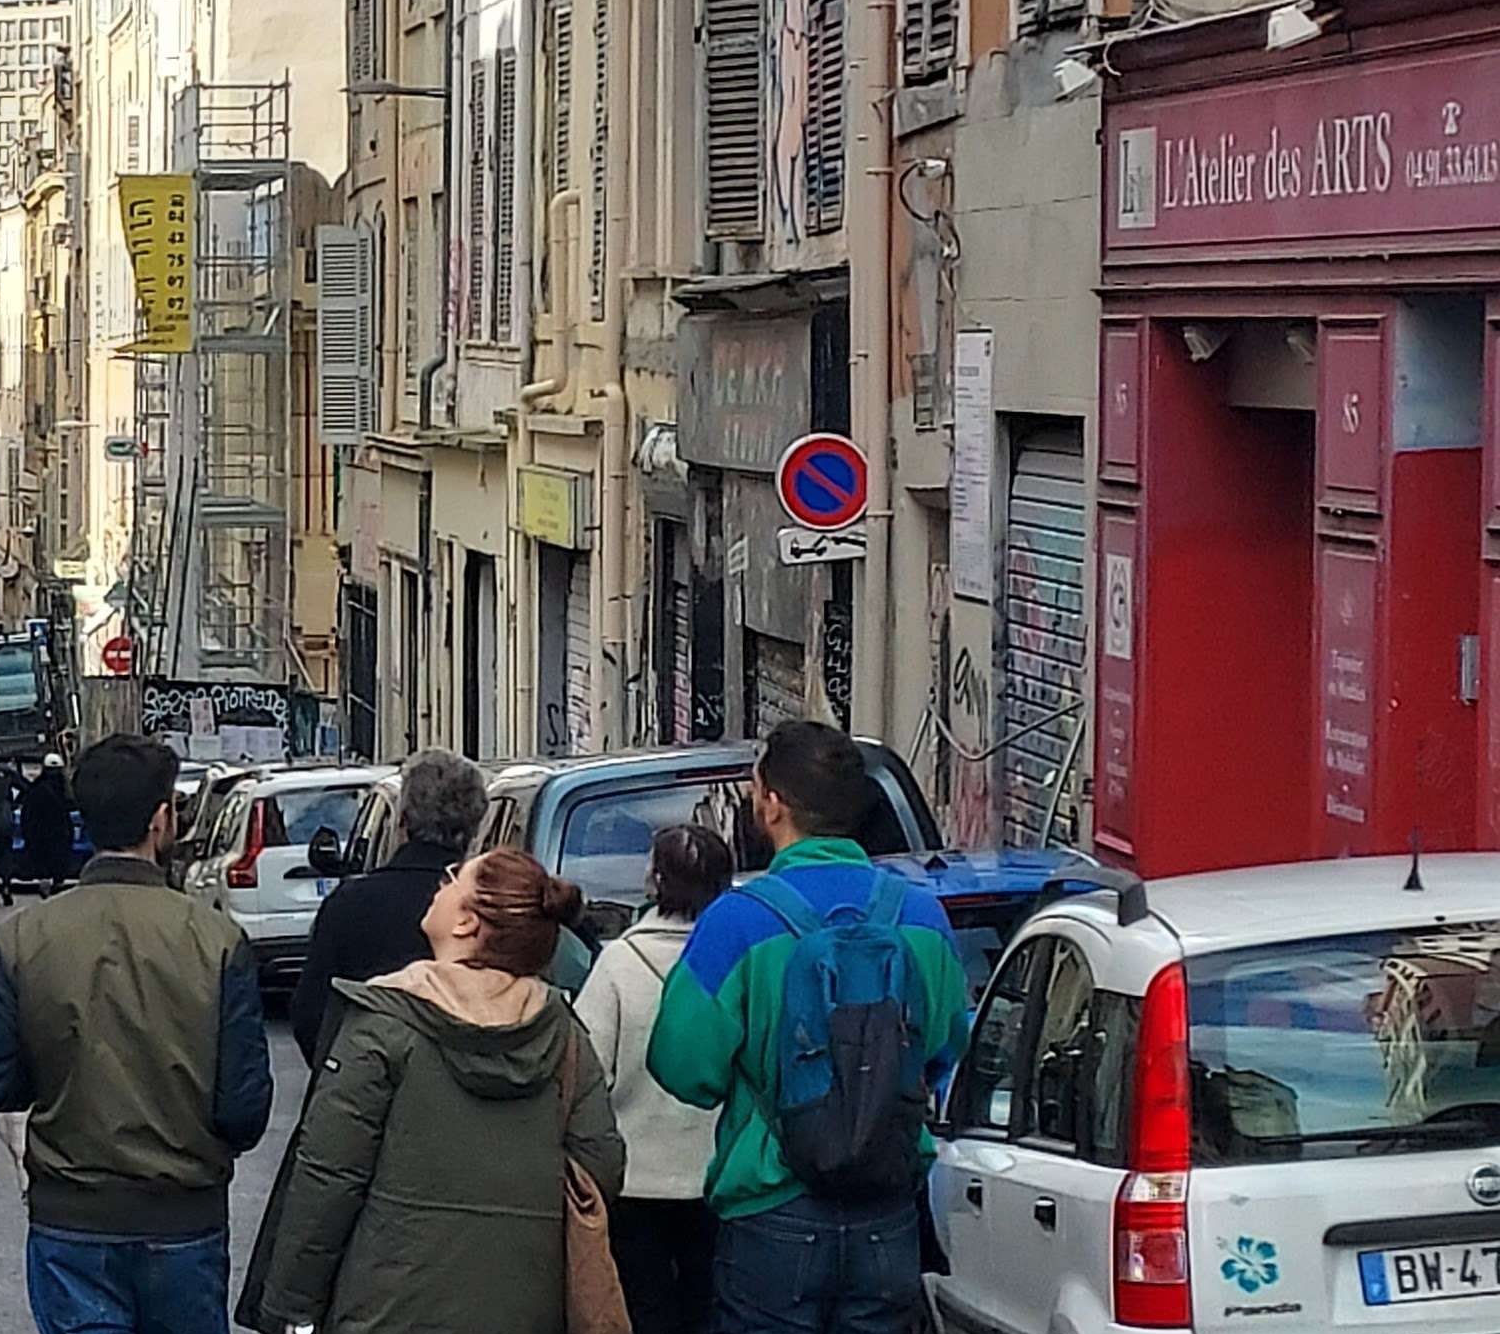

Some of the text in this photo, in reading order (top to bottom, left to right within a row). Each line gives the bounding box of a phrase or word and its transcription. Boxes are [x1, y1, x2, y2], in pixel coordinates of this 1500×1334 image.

[1162, 111, 1392, 208] L'Atelier des ARTS
